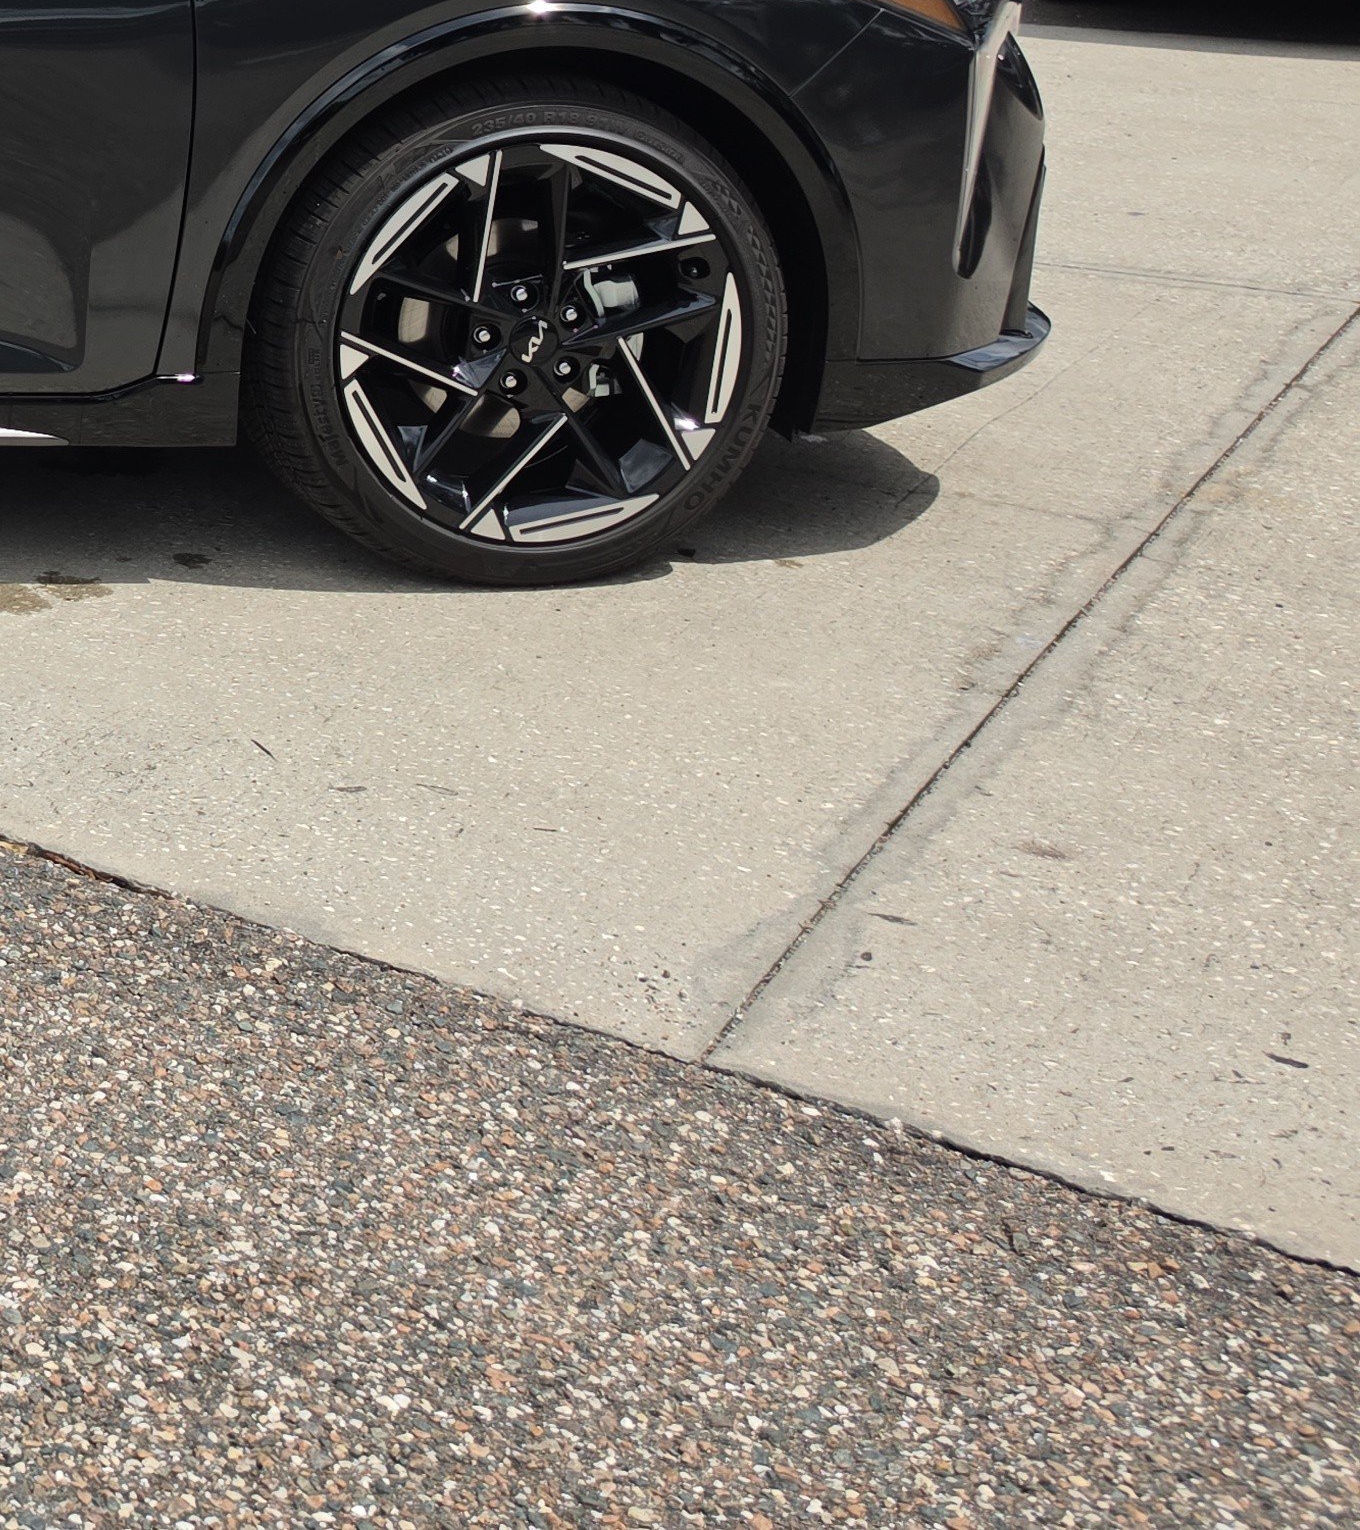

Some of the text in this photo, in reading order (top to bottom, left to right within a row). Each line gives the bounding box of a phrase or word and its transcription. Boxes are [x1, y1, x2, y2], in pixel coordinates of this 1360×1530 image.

[471, 112, 537, 137] 235/40
[543, 111, 580, 126] R18
[521, 320, 548, 363] KIA
[683, 403, 762, 510] KUMHO
